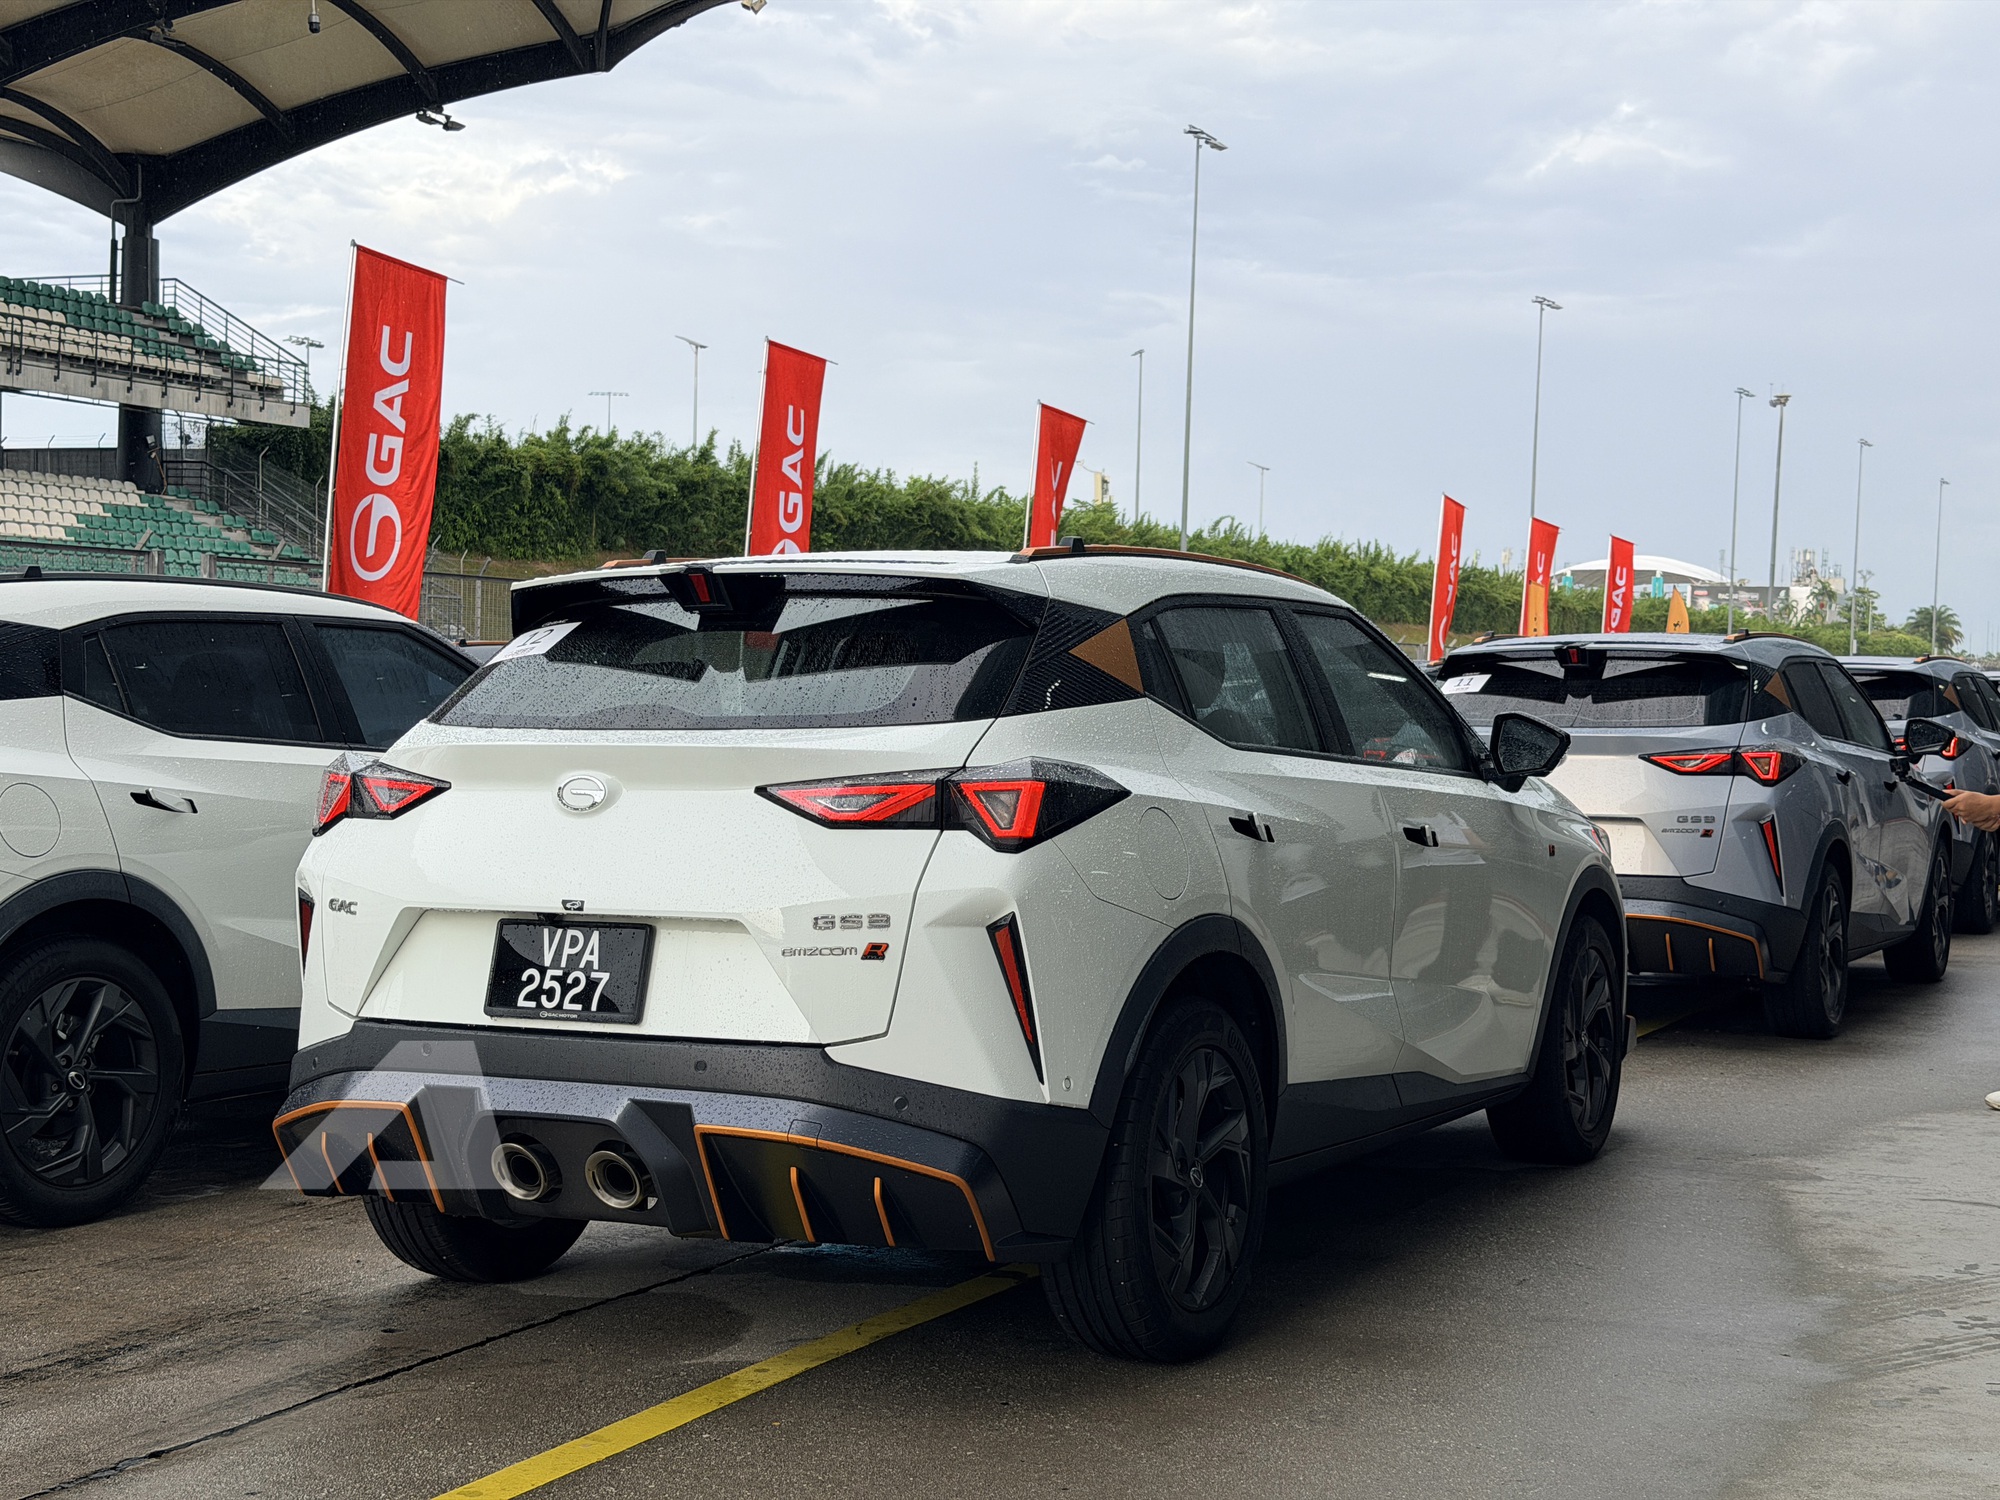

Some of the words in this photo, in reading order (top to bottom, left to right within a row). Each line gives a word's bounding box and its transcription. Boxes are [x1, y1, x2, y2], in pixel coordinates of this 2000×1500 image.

[365, 325, 413, 486] GAC
[779, 405, 804, 533] GAC
[516, 628, 555, 648] 12
[1453, 677, 1474, 688] 11
[328, 897, 358, 916] GAC
[812, 912, 891, 931] GS3
[542, 928, 600, 971] VPA
[861, 942, 889, 959] R
[516, 967, 611, 1012] 2527
